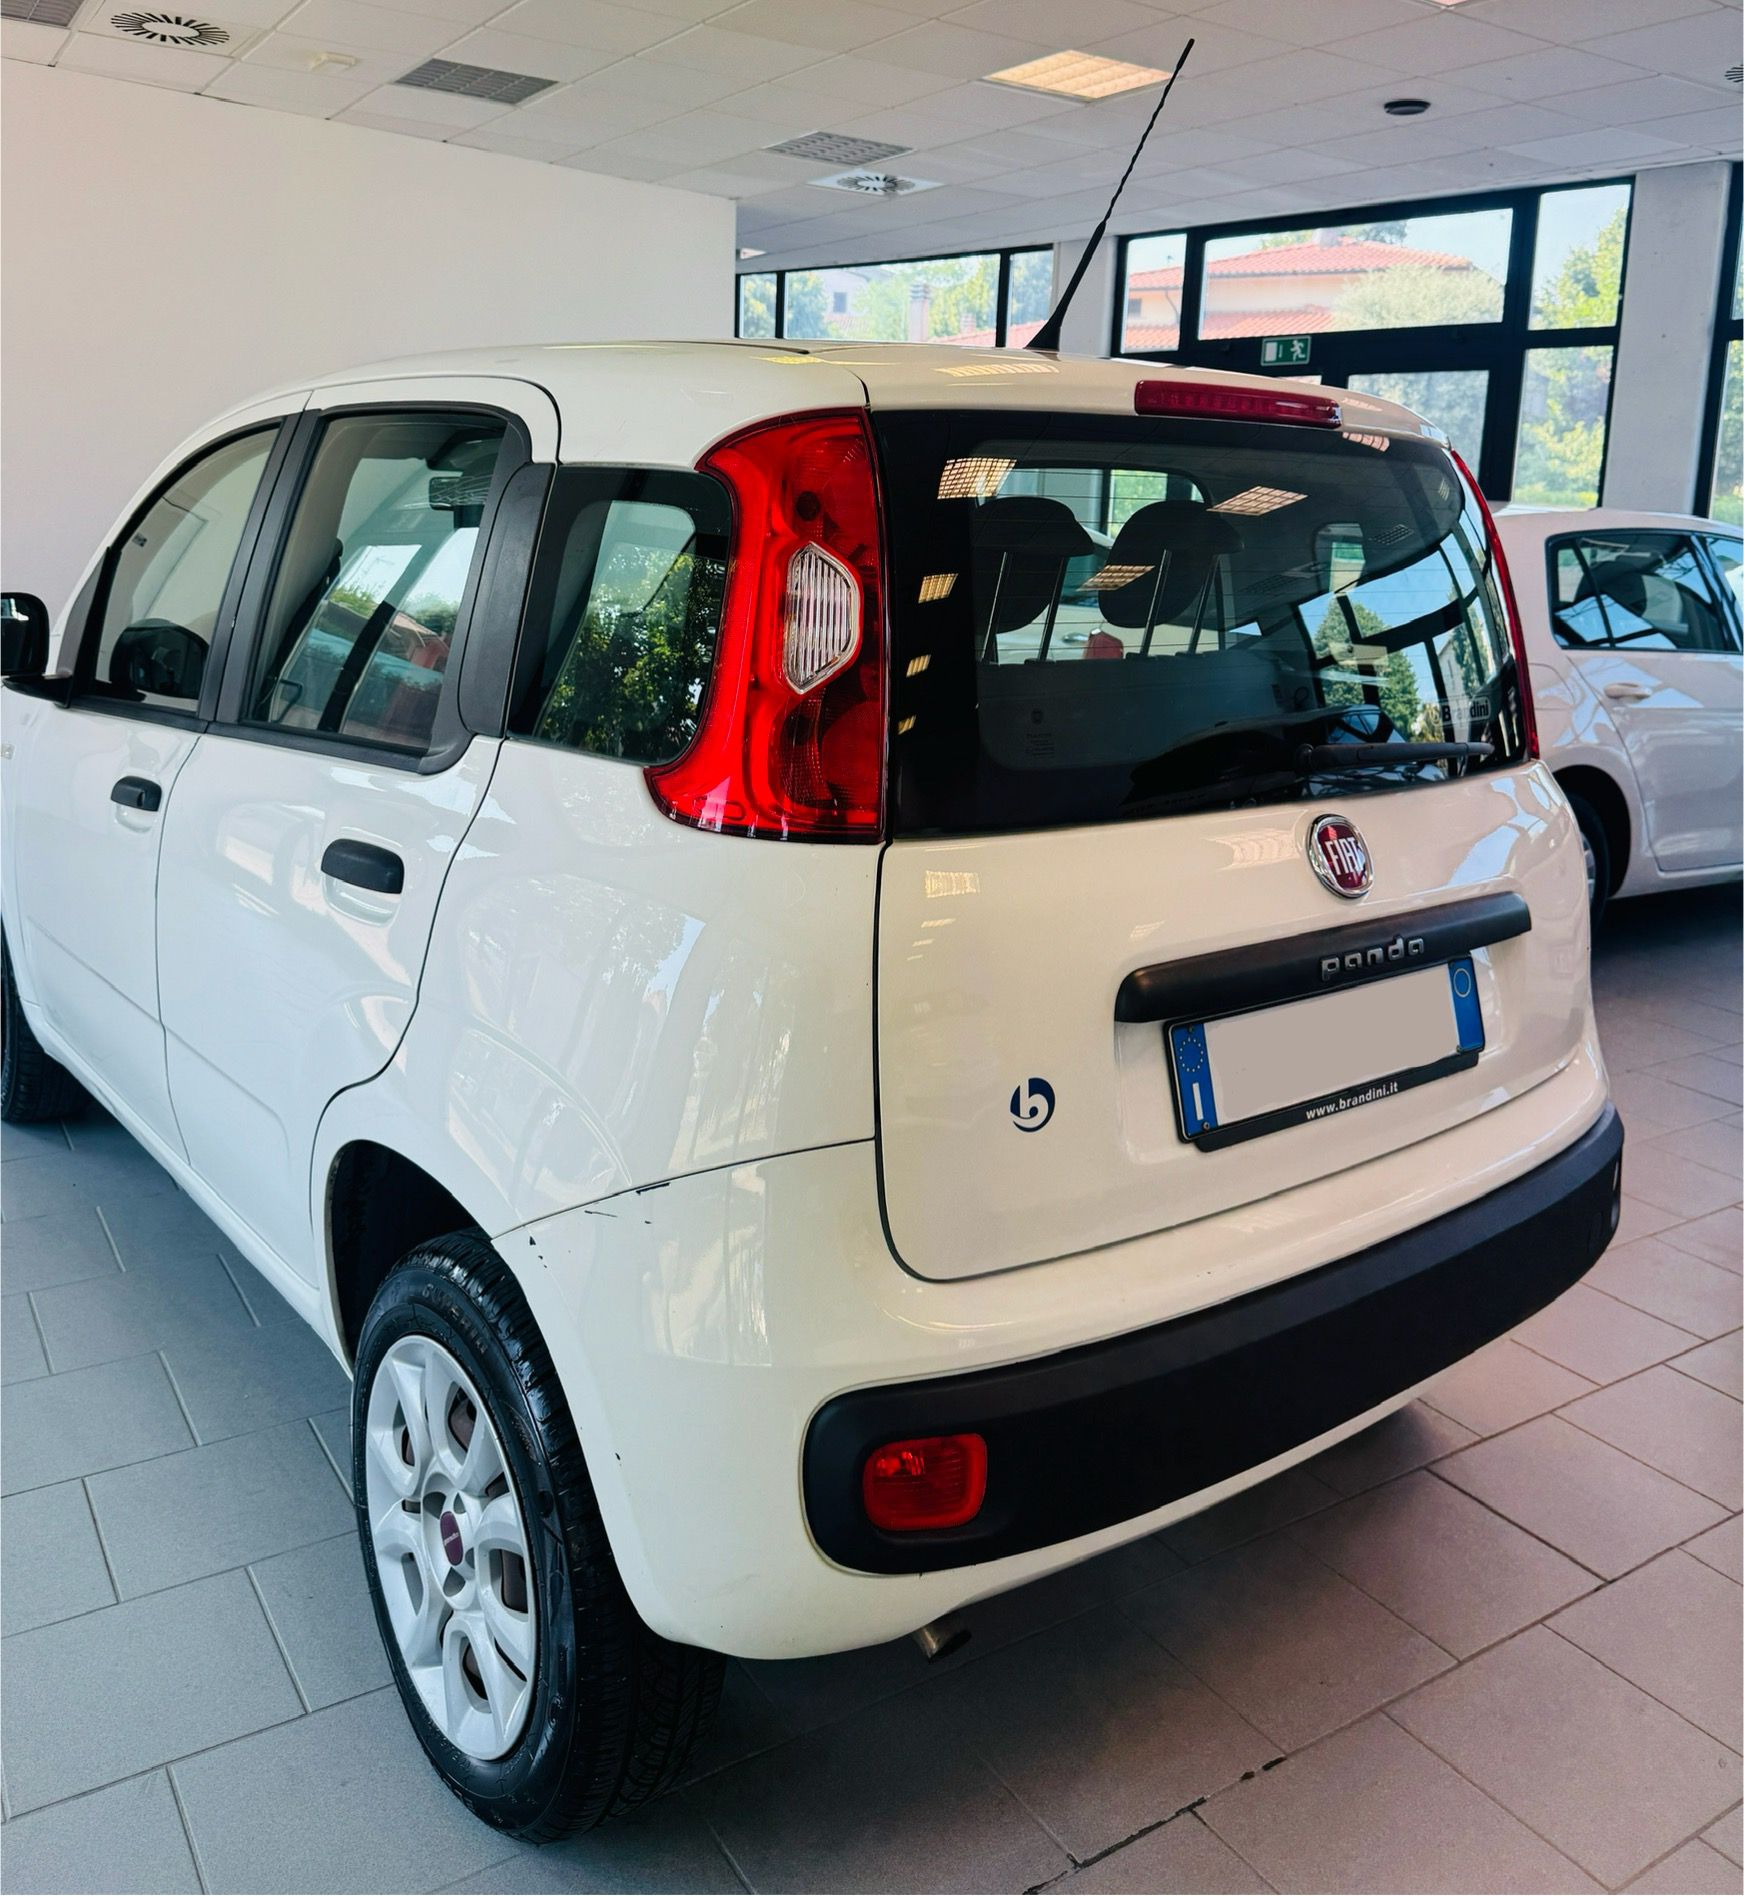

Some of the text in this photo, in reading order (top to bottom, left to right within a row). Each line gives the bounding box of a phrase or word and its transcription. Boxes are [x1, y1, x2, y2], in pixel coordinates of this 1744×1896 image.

[1324, 836, 1362, 876] FIAT
[1320, 935, 1425, 981] panda
[1305, 1081, 1399, 1120] www.brandini.it
